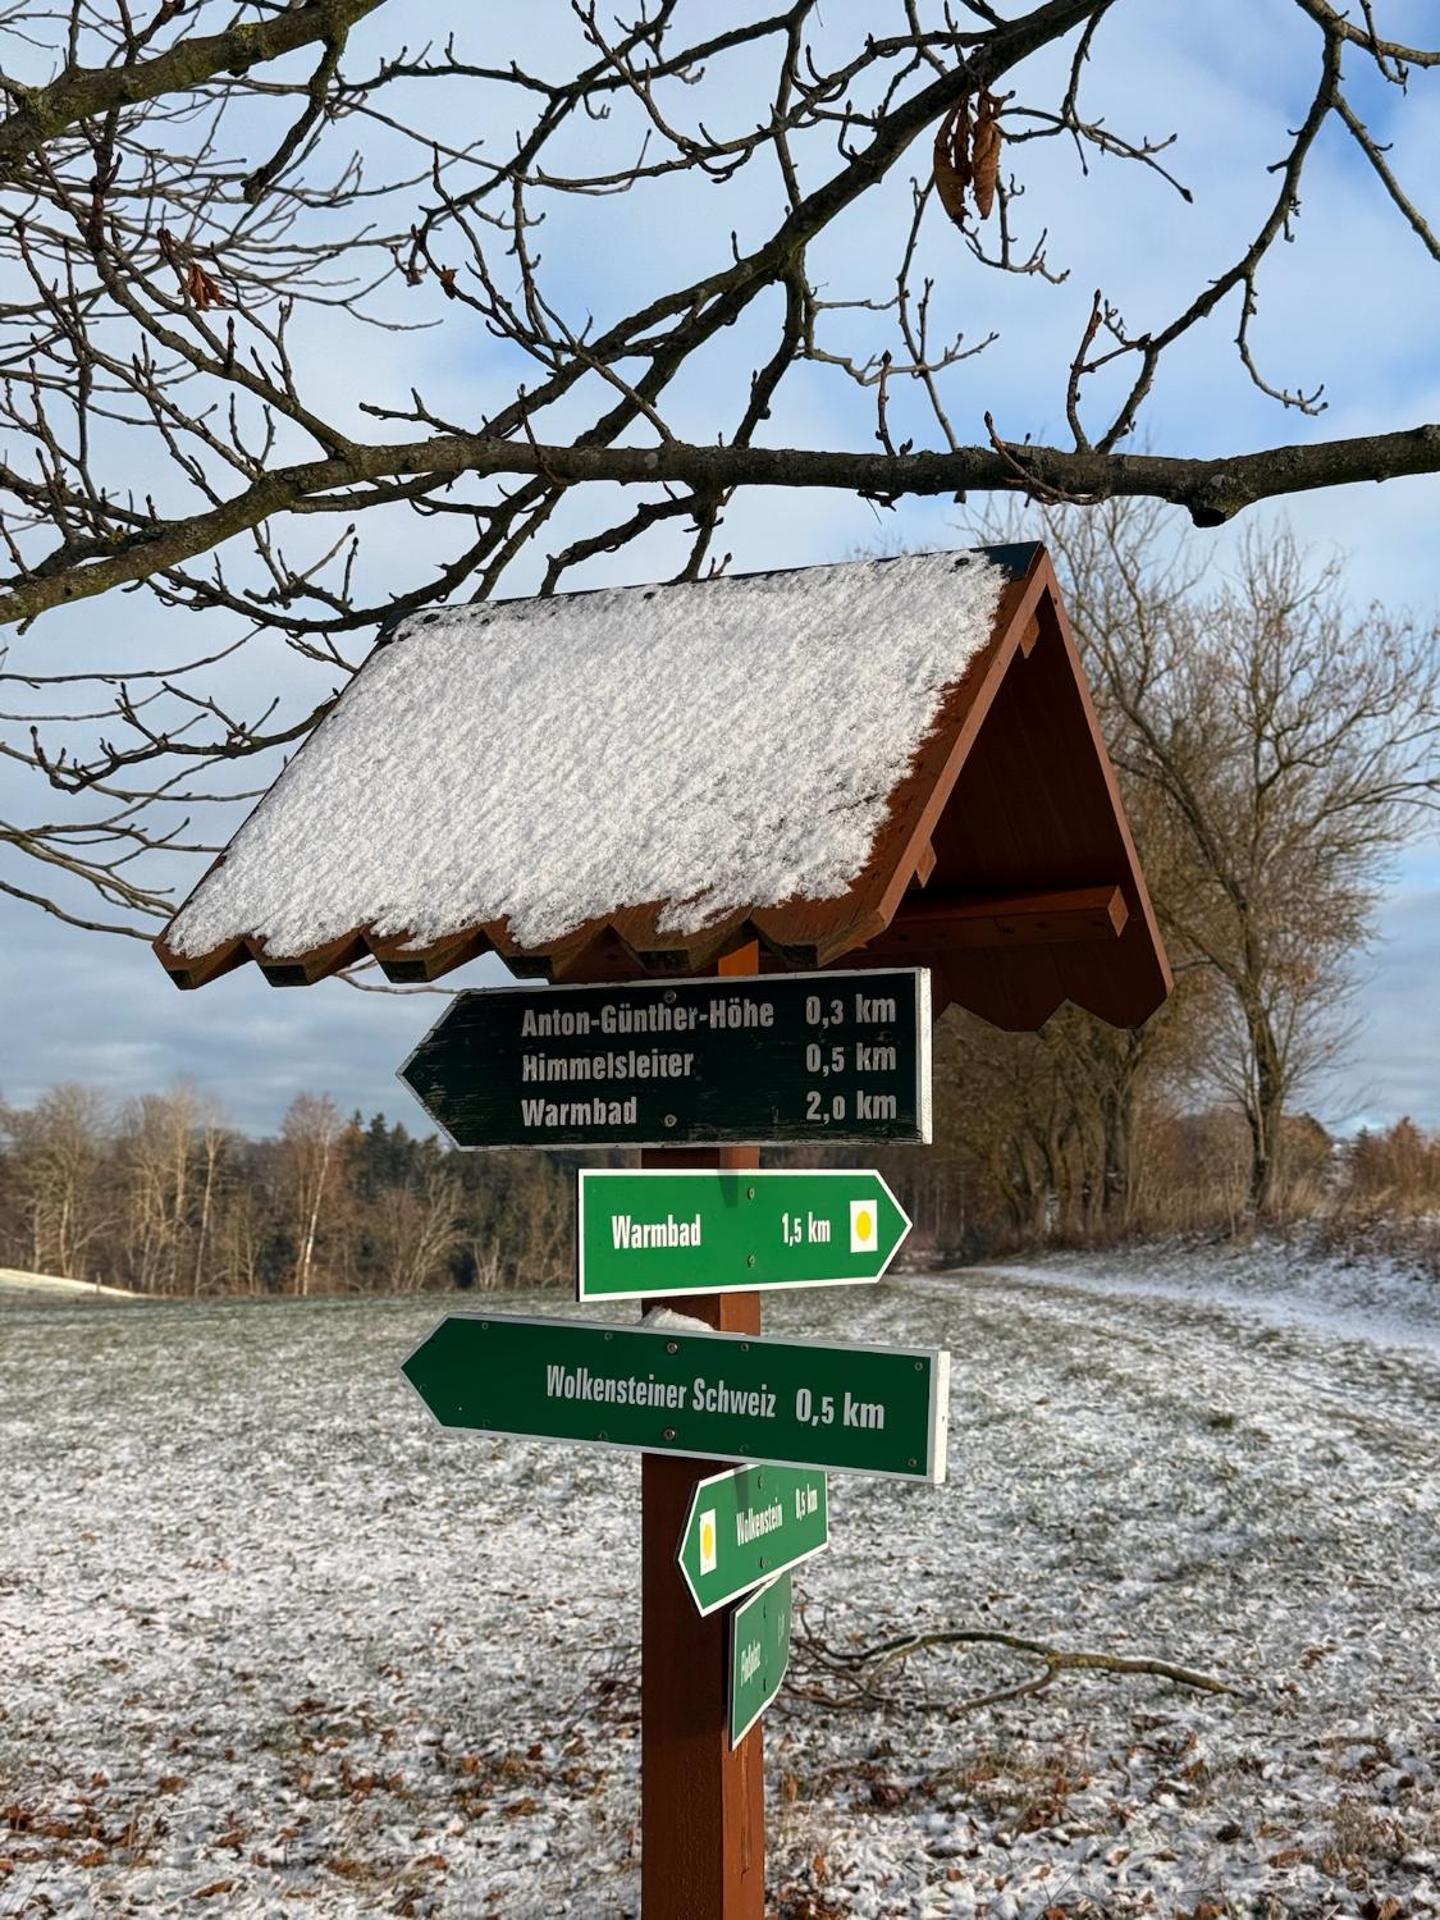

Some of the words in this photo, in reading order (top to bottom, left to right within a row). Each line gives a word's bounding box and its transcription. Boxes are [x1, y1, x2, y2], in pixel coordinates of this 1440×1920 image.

[521, 998, 775, 1037] Anton-Günther-Höhe
[806, 996, 844, 1029] 0,3
[856, 994, 897, 1023] km
[521, 1048, 694, 1082] Himmelsleiter
[806, 1043, 845, 1076] 0,5
[856, 1042, 897, 1071] km
[521, 1096, 638, 1127] Warmbad
[806, 1091, 845, 1124] 2,0
[856, 1090, 897, 1120] km
[611, 1214, 701, 1249] Warmbad
[782, 1212, 802, 1247] 1,5
[808, 1211, 831, 1243] km
[546, 1364, 687, 1409] Wolkensteiner
[692, 1377, 777, 1418] Schweiz
[795, 1387, 834, 1426] 0,5
[843, 1392, 885, 1429] km
[736, 1498, 783, 1547] Wolkenstein
[806, 1483, 818, 1514] km
